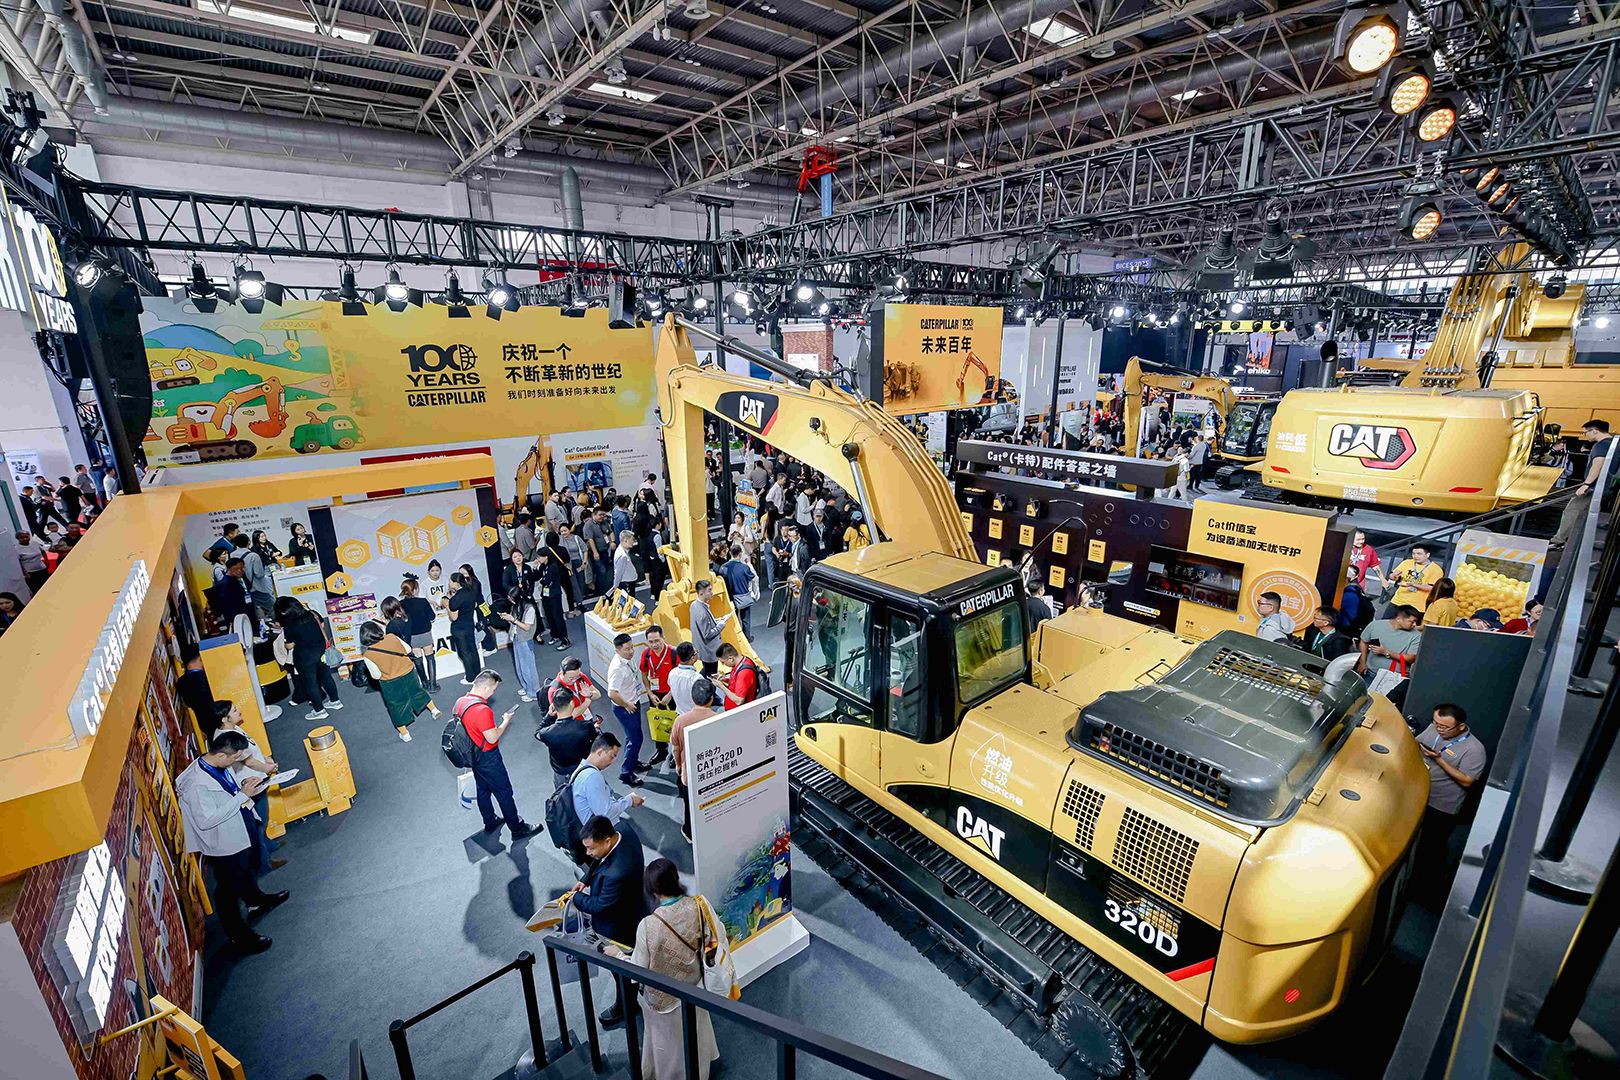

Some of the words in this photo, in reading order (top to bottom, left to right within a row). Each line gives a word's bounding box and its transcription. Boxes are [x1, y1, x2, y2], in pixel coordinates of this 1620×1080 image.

[34, 291, 78, 334] YEARS
[920, 318, 960, 330] CATERPILLAR
[502, 342, 572, 362] 庆祝一个
[921, 335, 973, 355] 未来百年
[400, 343, 478, 373] 100
[406, 372, 481, 388] YEARS
[504, 363, 623, 384] 不断革新的世纪
[407, 390, 488, 408] CATERPILLAR
[507, 385, 617, 400] 我们时刻准备好向未来出发
[738, 394, 765, 429] CAT
[1328, 422, 1398, 461] CAT
[1207, 517, 1257, 536] Cat价值宝
[1206, 532, 1302, 558] 为设备添加无忧守护
[430, 585, 445, 596] CAT
[960, 583, 1015, 617] CATERPILLAR
[759, 704, 779, 724] CAT
[696, 746, 721, 762] 新动力
[719, 750, 736, 764] 320
[736, 746, 744, 757] D
[984, 746, 1013, 773] 燃油
[698, 759, 739, 783] 液压挖掘机
[956, 805, 1006, 861] CAT
[1104, 899, 1179, 958] 320D
